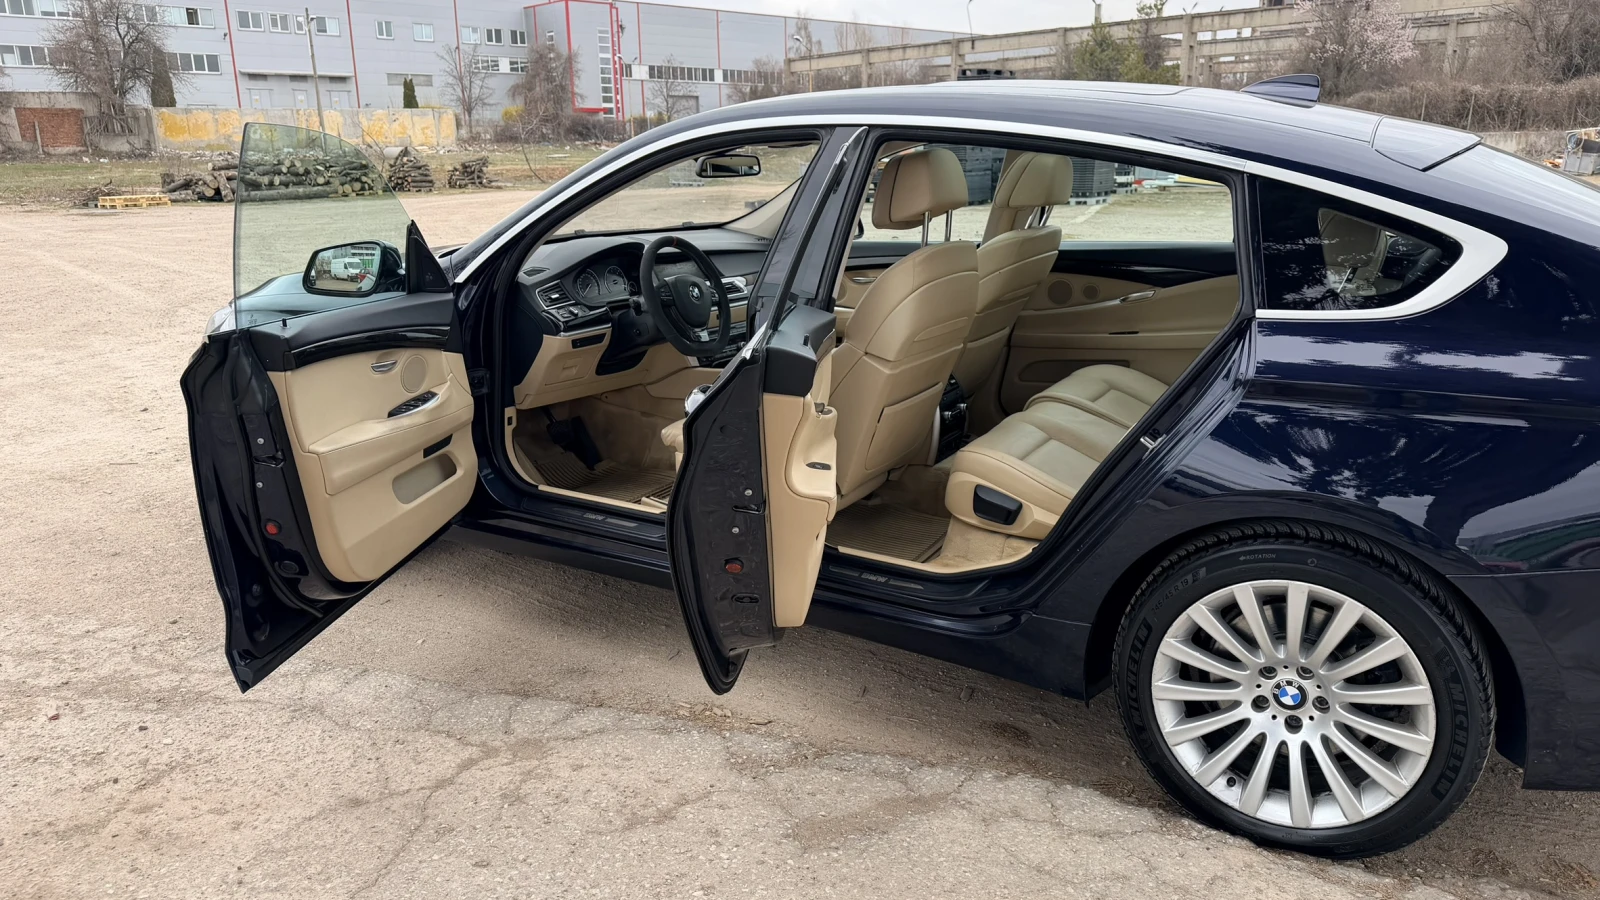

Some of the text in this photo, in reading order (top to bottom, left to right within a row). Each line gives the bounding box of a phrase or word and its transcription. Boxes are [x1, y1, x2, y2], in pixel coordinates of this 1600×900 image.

[1246, 553, 1277, 561] ROTATION
[1173, 584, 1180, 593] R
[1180, 578, 1189, 588] 19
[1126, 623, 1151, 728] MICHELIN
[1272, 680, 1300, 695] BMW
[1436, 683, 1467, 797] MICHELIN
